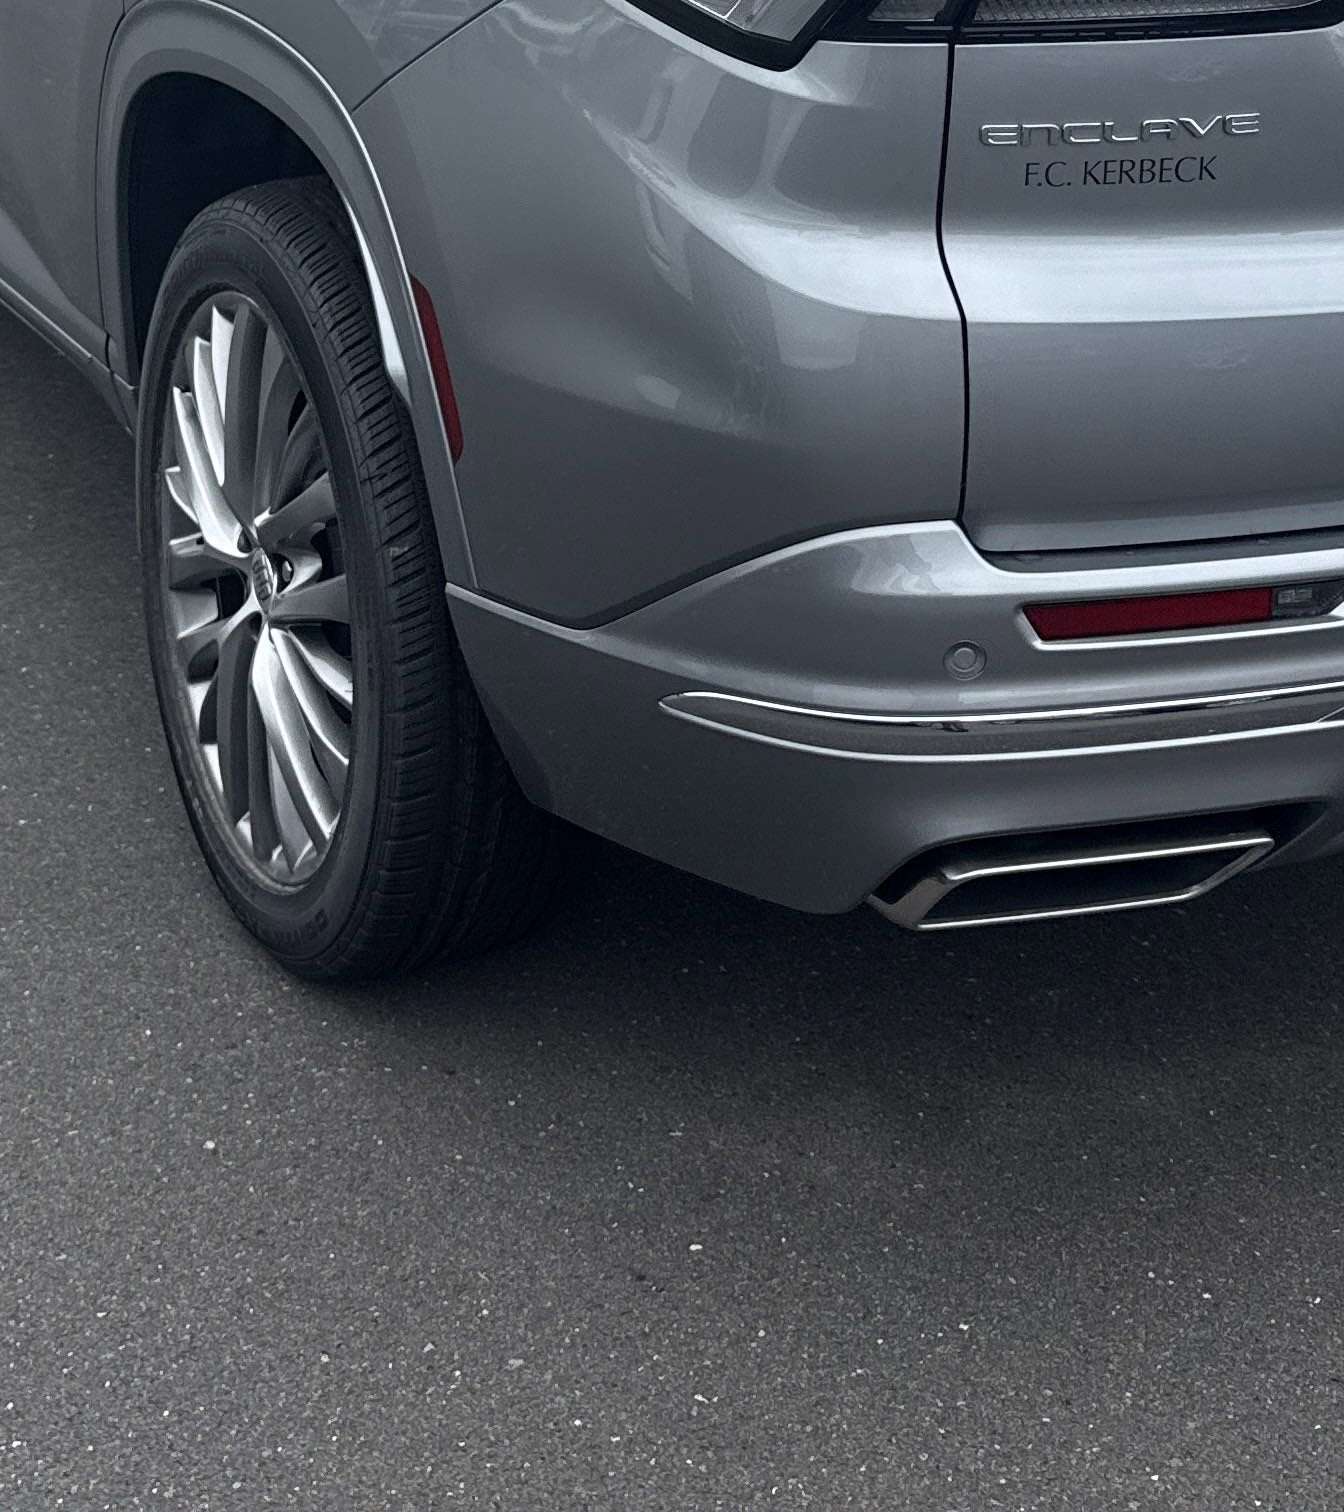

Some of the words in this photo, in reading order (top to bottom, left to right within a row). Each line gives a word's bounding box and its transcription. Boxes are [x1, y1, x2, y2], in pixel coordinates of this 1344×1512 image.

[978, 112, 1261, 146] ENCLAVE
[1024, 160, 1072, 187] F.C.
[1082, 155, 1217, 186] KERBECK
